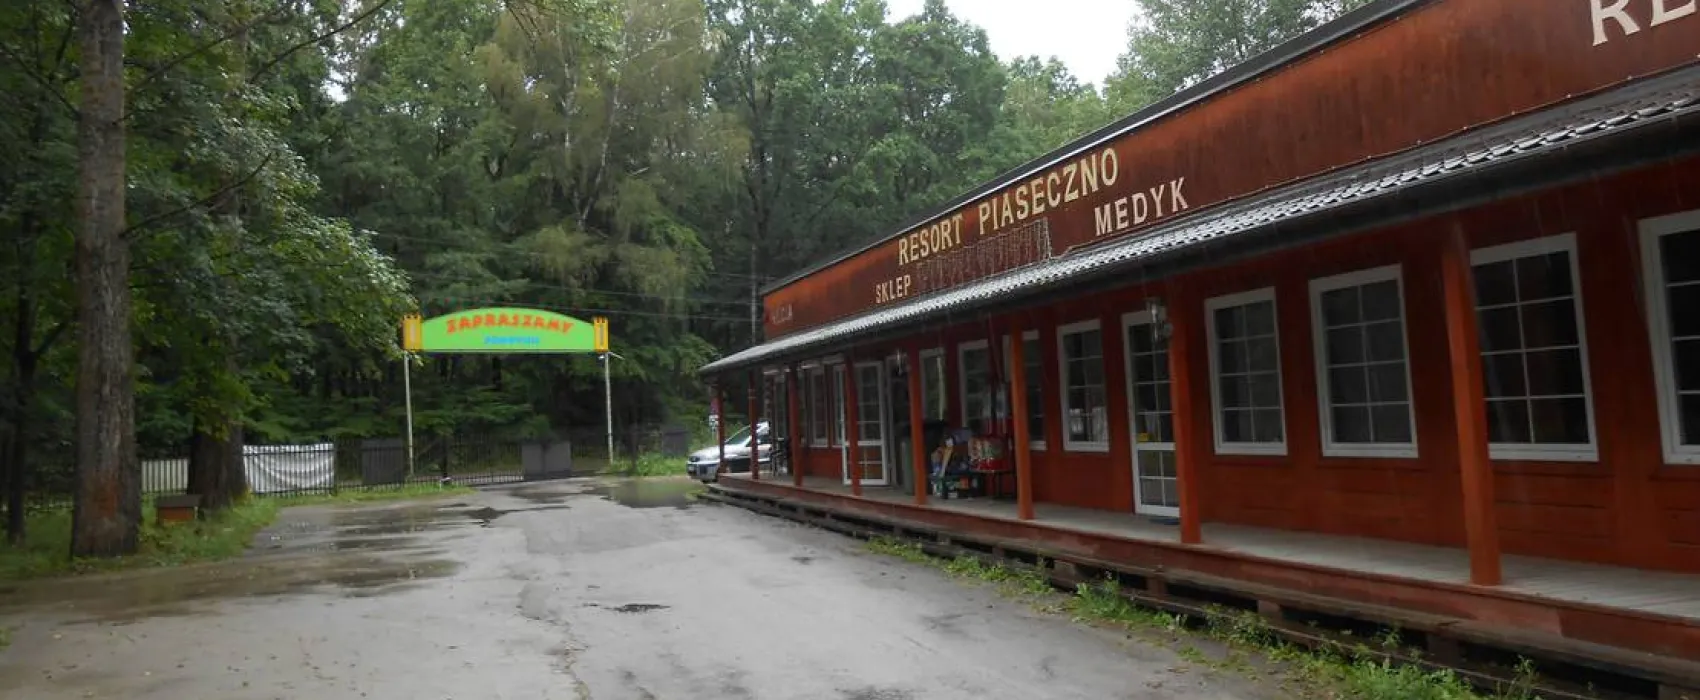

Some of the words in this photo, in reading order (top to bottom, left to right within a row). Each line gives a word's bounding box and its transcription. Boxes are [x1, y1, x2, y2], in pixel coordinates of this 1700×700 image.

[898, 213, 963, 266] RESORT
[978, 148, 1119, 236] PIASECZNO
[1094, 177, 1189, 237] MEDYK
[875, 275, 911, 304] SKLEP
